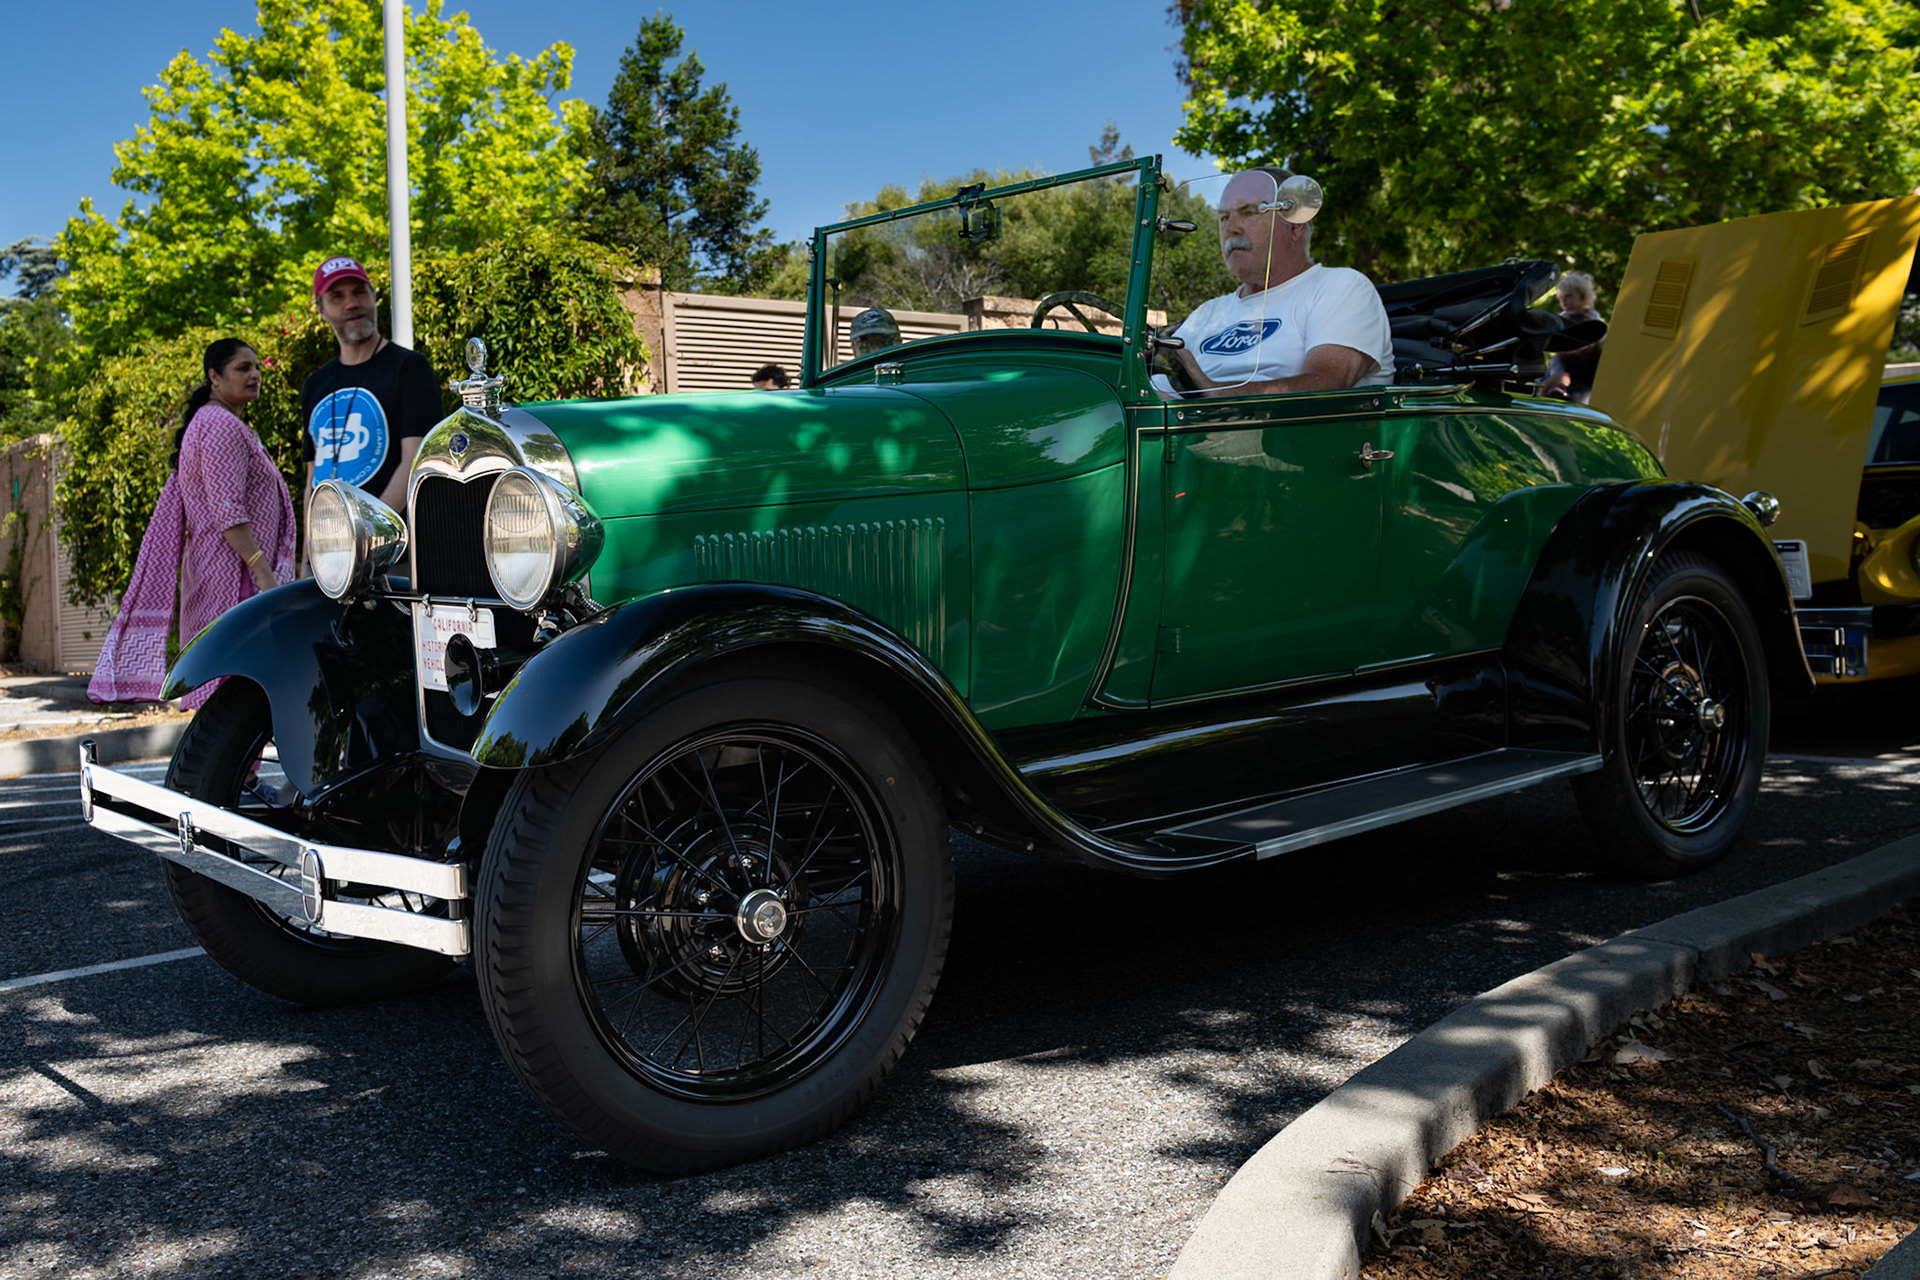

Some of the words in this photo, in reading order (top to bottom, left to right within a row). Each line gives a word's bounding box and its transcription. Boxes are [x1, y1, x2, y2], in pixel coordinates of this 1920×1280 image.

[1210, 324, 1267, 349] Ford
[432, 618, 474, 633] CALIFORNIA
[423, 657, 444, 672] VEHICL
